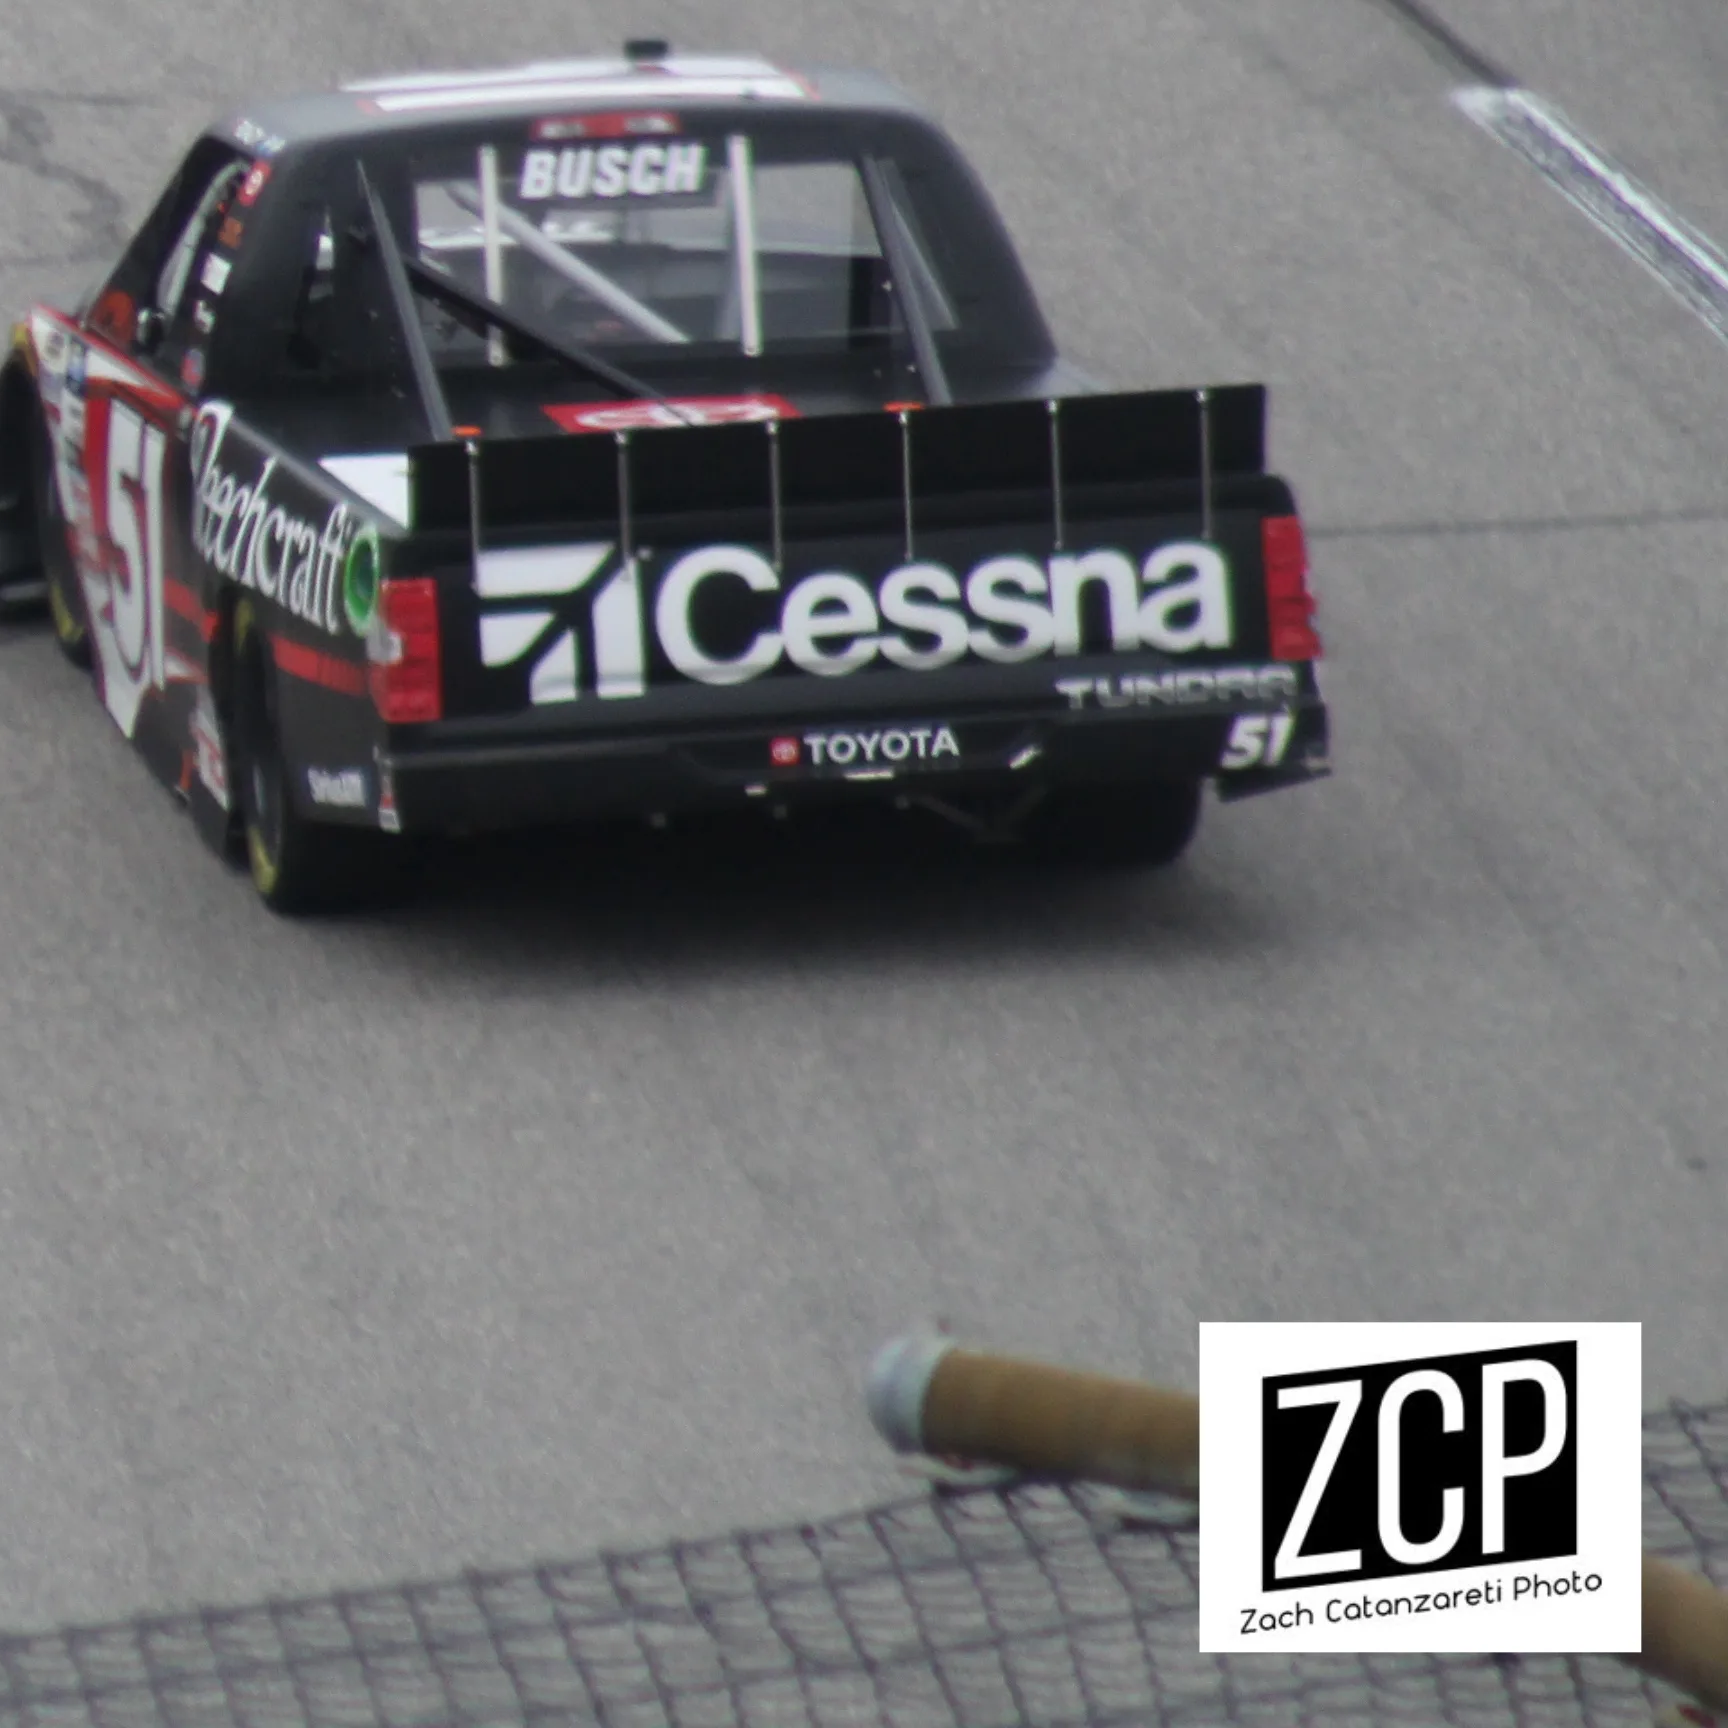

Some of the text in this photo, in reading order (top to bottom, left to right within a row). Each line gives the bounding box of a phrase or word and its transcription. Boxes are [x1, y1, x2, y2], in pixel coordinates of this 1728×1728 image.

[519, 143, 706, 200] BUSCH
[106, 396, 168, 692] 51
[655, 540, 1233, 686] Cessna
[1054, 664, 1297, 710] TUNDRA
[803, 726, 960, 766] TOYOTA
[1220, 712, 1294, 770] 51
